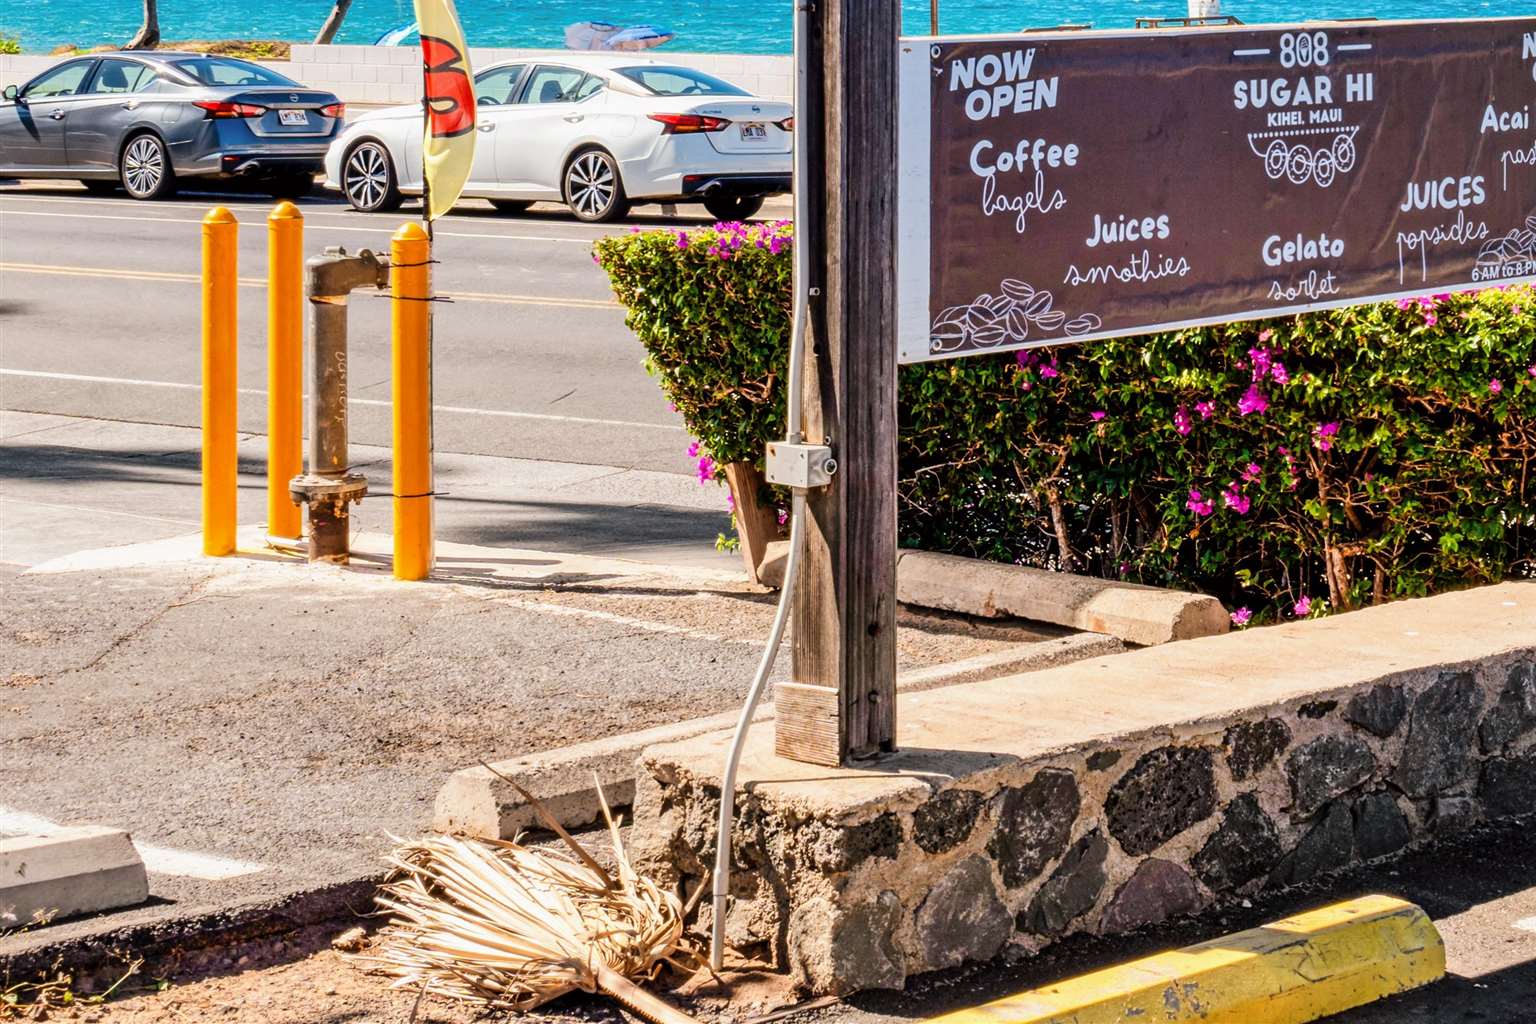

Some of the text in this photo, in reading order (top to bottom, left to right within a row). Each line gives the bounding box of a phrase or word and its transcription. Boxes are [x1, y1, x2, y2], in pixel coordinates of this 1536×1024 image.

[1280, 31, 1329, 68] 808
[950, 48, 1036, 91] NOW
[965, 76, 1058, 120] OPEN
[1234, 73, 1373, 110] SUGAR HI
[1309, 108, 1342, 124] MAUI
[1480, 104, 1529, 134] Acai
[970, 138, 1079, 177] Coffee
[983, 170, 1067, 233] bagels
[1400, 176, 1486, 212] JUICES
[1086, 214, 1170, 247] Juices
[1064, 249, 1191, 286] smothies
[1262, 233, 1345, 266] Gelato
[1266, 270, 1340, 301] sorbet
[1471, 267, 1479, 282] 6
[1481, 265, 1500, 280] AM
[1502, 264, 1514, 277] to
